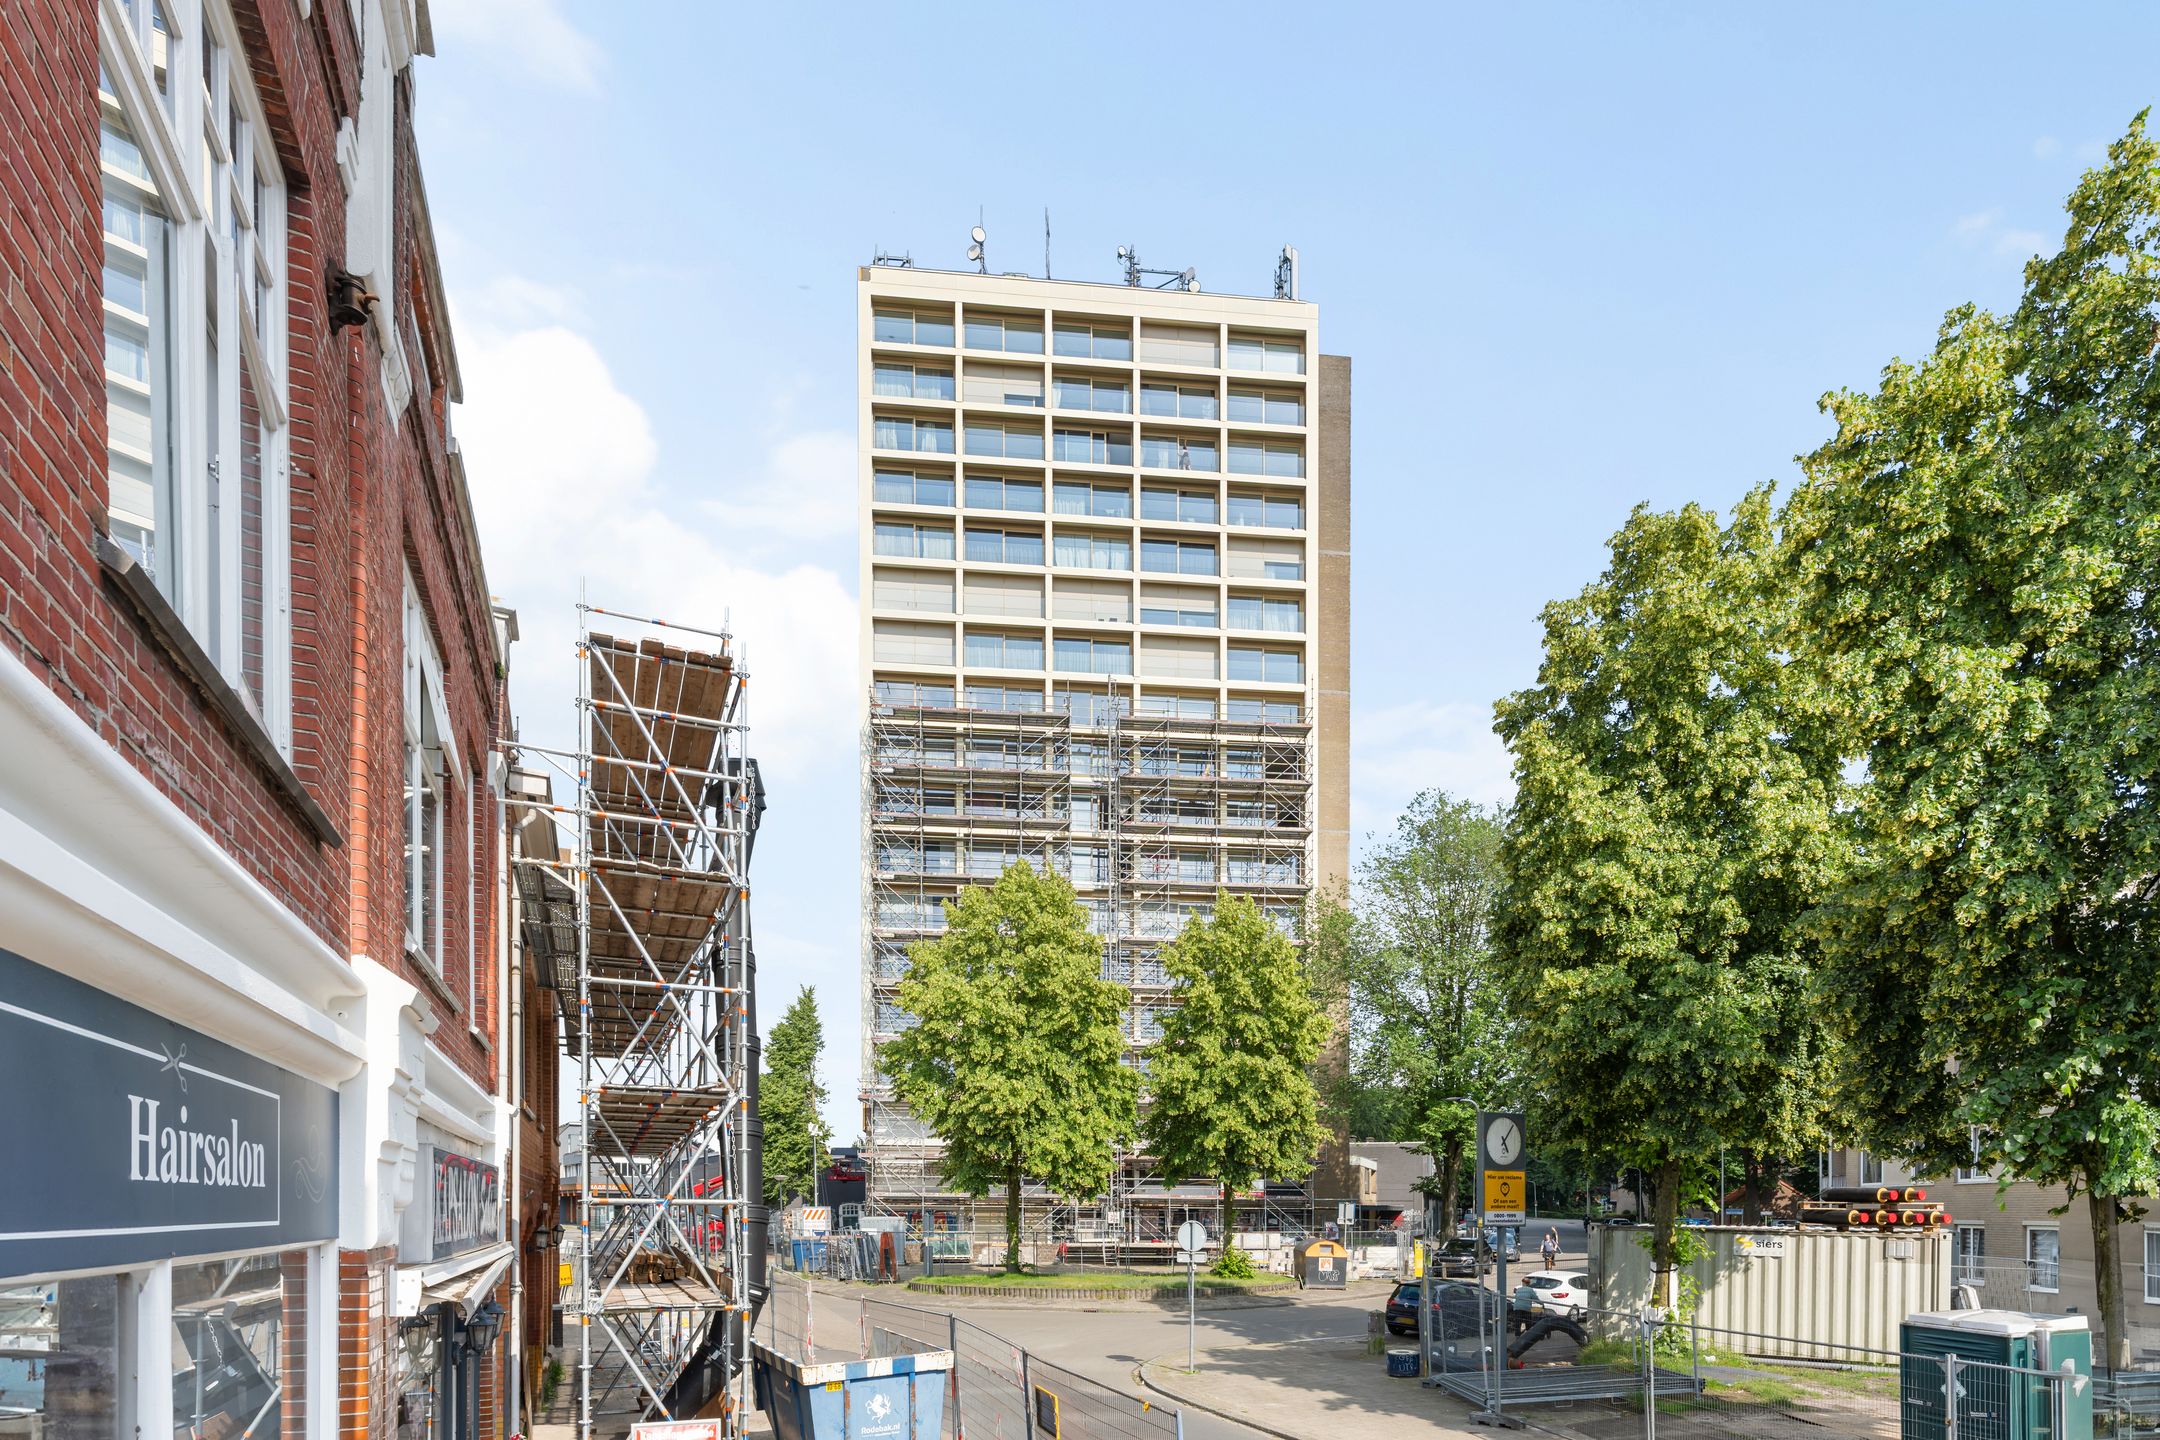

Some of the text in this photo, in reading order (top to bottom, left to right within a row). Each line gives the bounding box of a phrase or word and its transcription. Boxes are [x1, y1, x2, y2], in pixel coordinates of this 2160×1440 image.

[128, 1094, 266, 1187] Hairsalon
[1756, 1240, 1783, 1248] siers
[861, 1423, 900, 1434] Rodebak.nl
